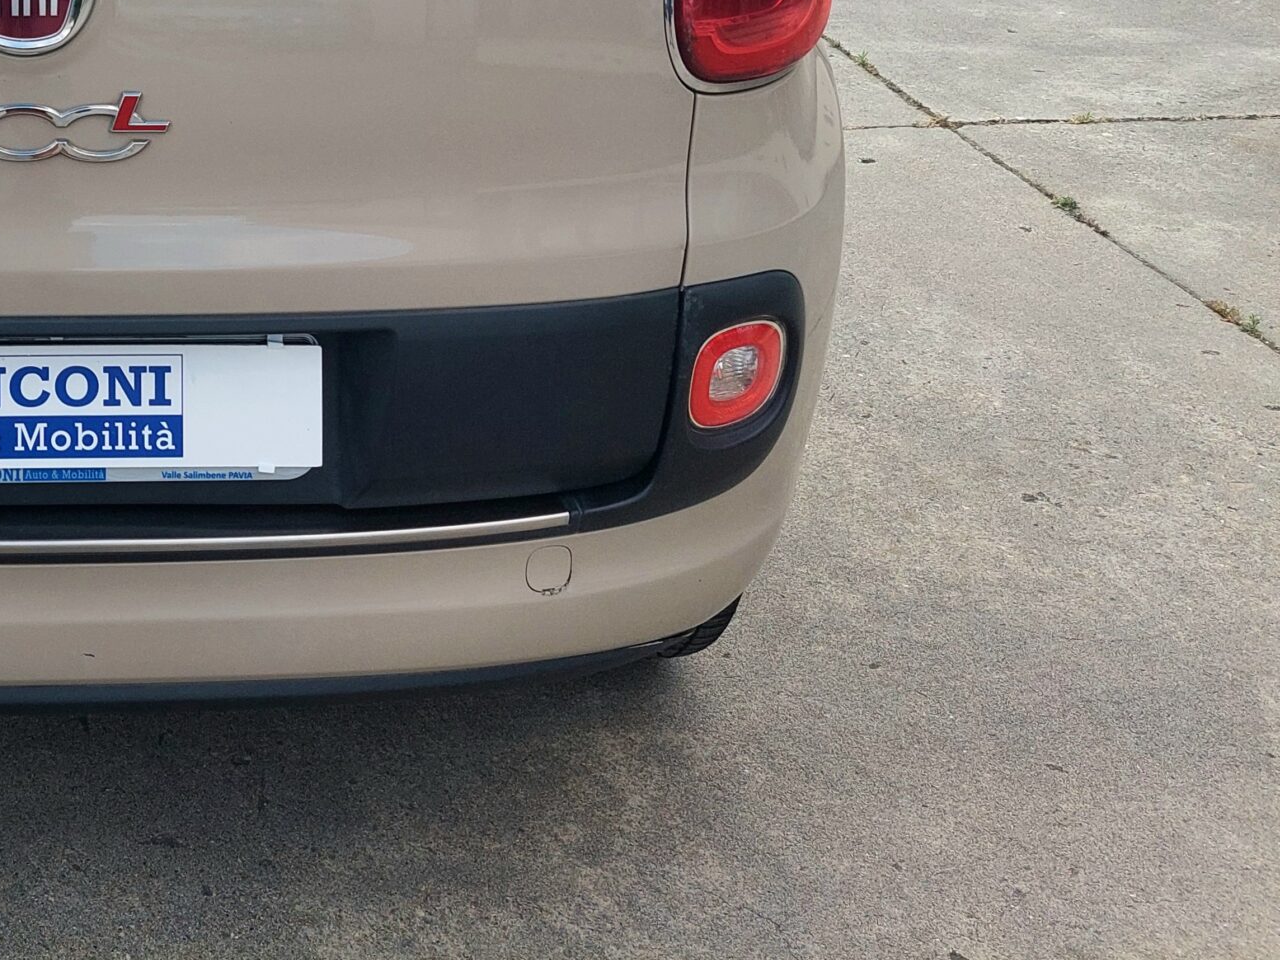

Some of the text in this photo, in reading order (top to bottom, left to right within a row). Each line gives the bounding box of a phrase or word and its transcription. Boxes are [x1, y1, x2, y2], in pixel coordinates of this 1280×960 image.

[14, 419, 176, 452] Mobilità
[25, 469, 48, 480] Auto
[51, 469, 59, 480] &
[62, 467, 105, 480] Mobilità
[161, 471, 253, 479] Valle Salimbene PAVIA
